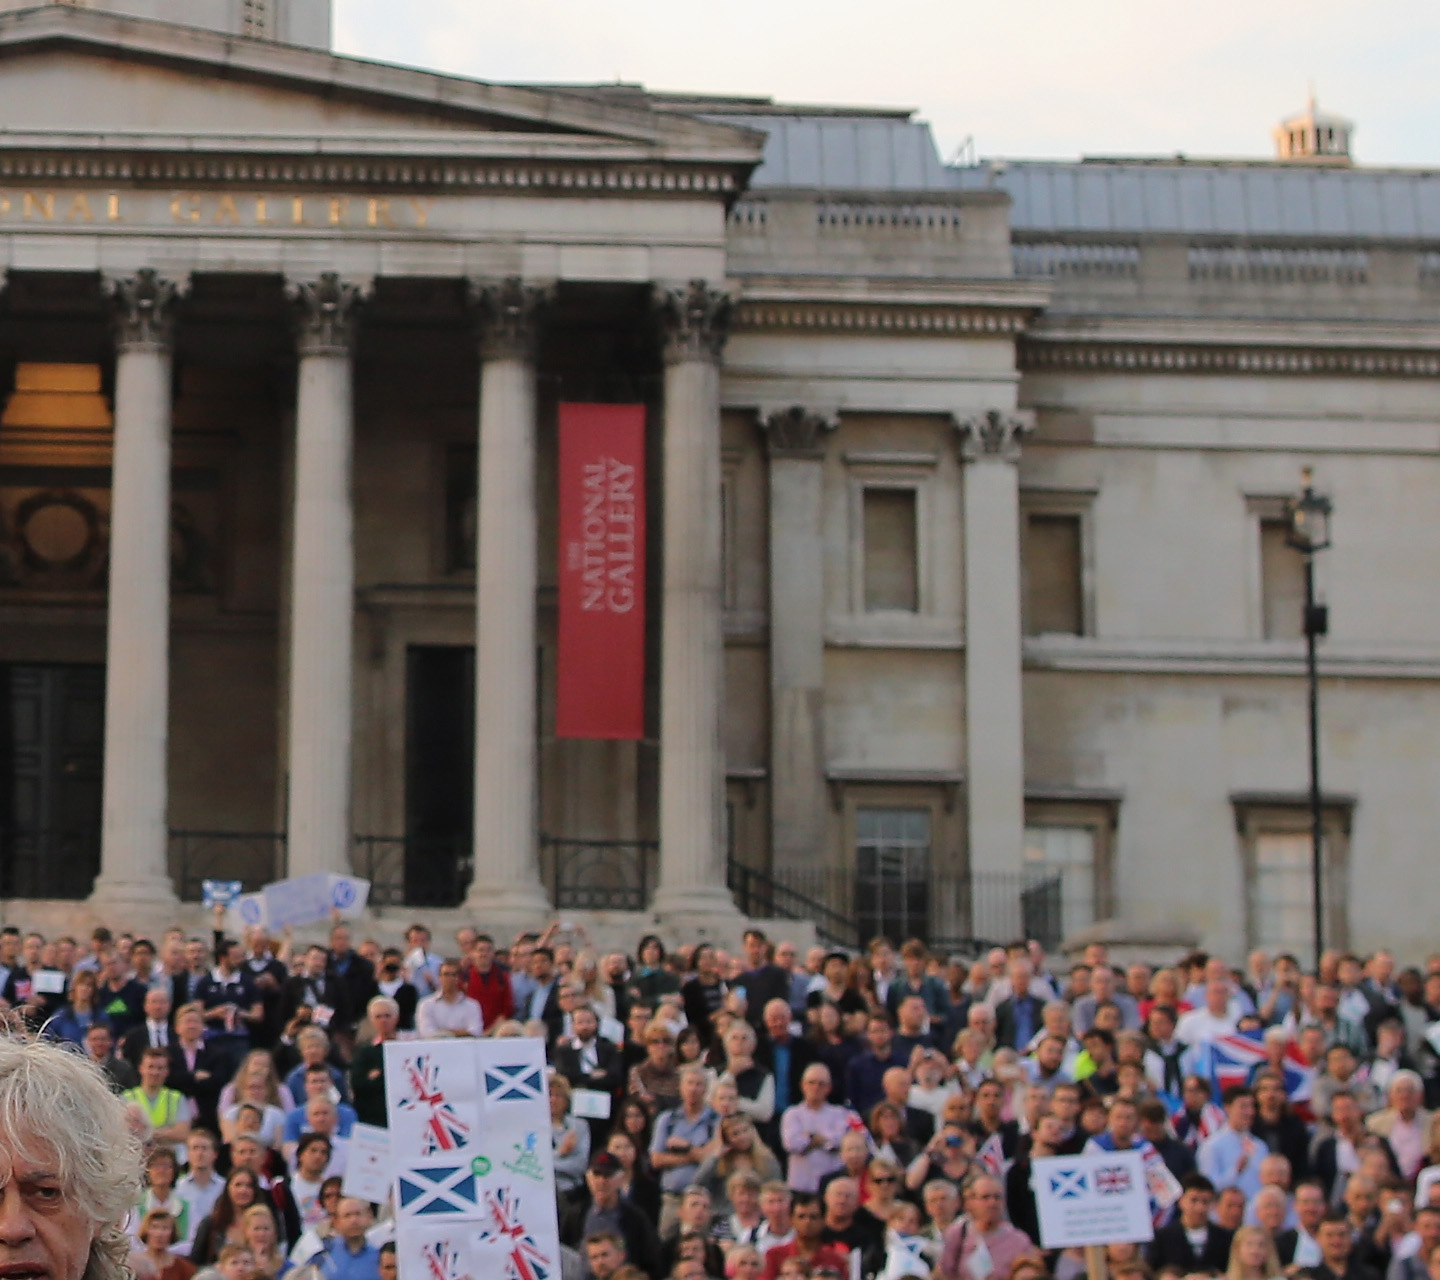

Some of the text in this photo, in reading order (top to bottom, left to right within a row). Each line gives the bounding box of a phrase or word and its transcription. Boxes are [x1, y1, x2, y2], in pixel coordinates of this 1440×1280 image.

[170, 194, 438, 228] GALLERY
[581, 455, 608, 613] NATIONAL
[607, 457, 635, 614] GALLERY
